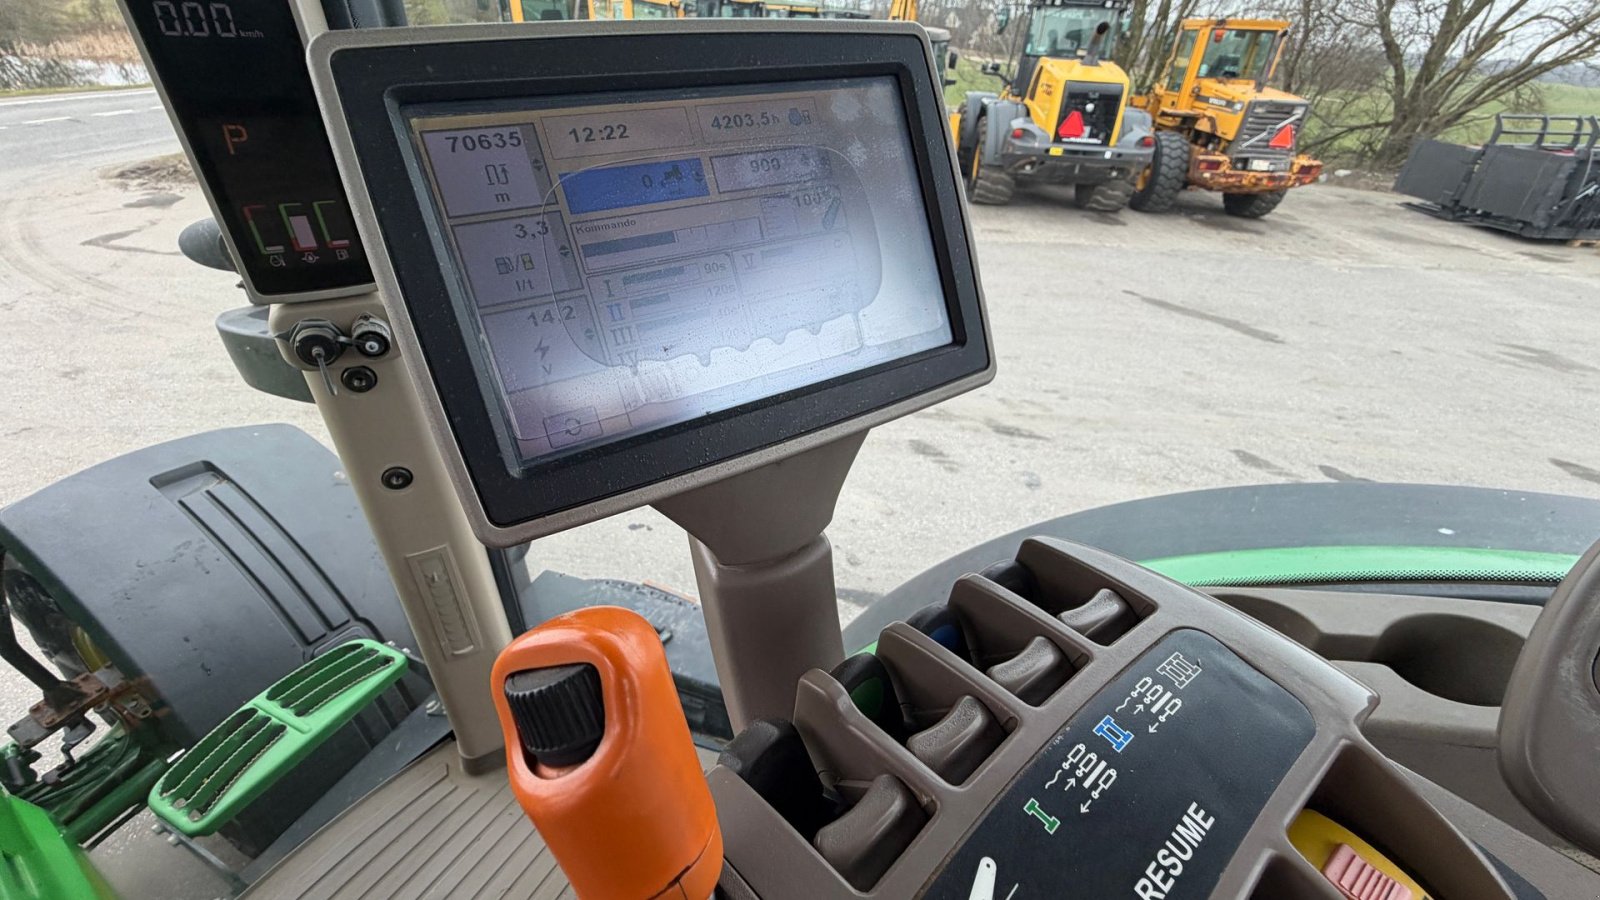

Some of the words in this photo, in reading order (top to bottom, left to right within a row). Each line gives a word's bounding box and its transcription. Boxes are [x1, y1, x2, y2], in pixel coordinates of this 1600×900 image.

[711, 111, 771, 130] 4203,5
[222, 124, 248, 155] P
[445, 131, 522, 154] 70635
[568, 123, 630, 144] 12:22
[495, 191, 511, 203] m
[514, 220, 550, 239] 3,3
[575, 218, 637, 234] Kommando
[1093, 714, 1135, 753] II
[1134, 801, 1216, 900] RESUME
